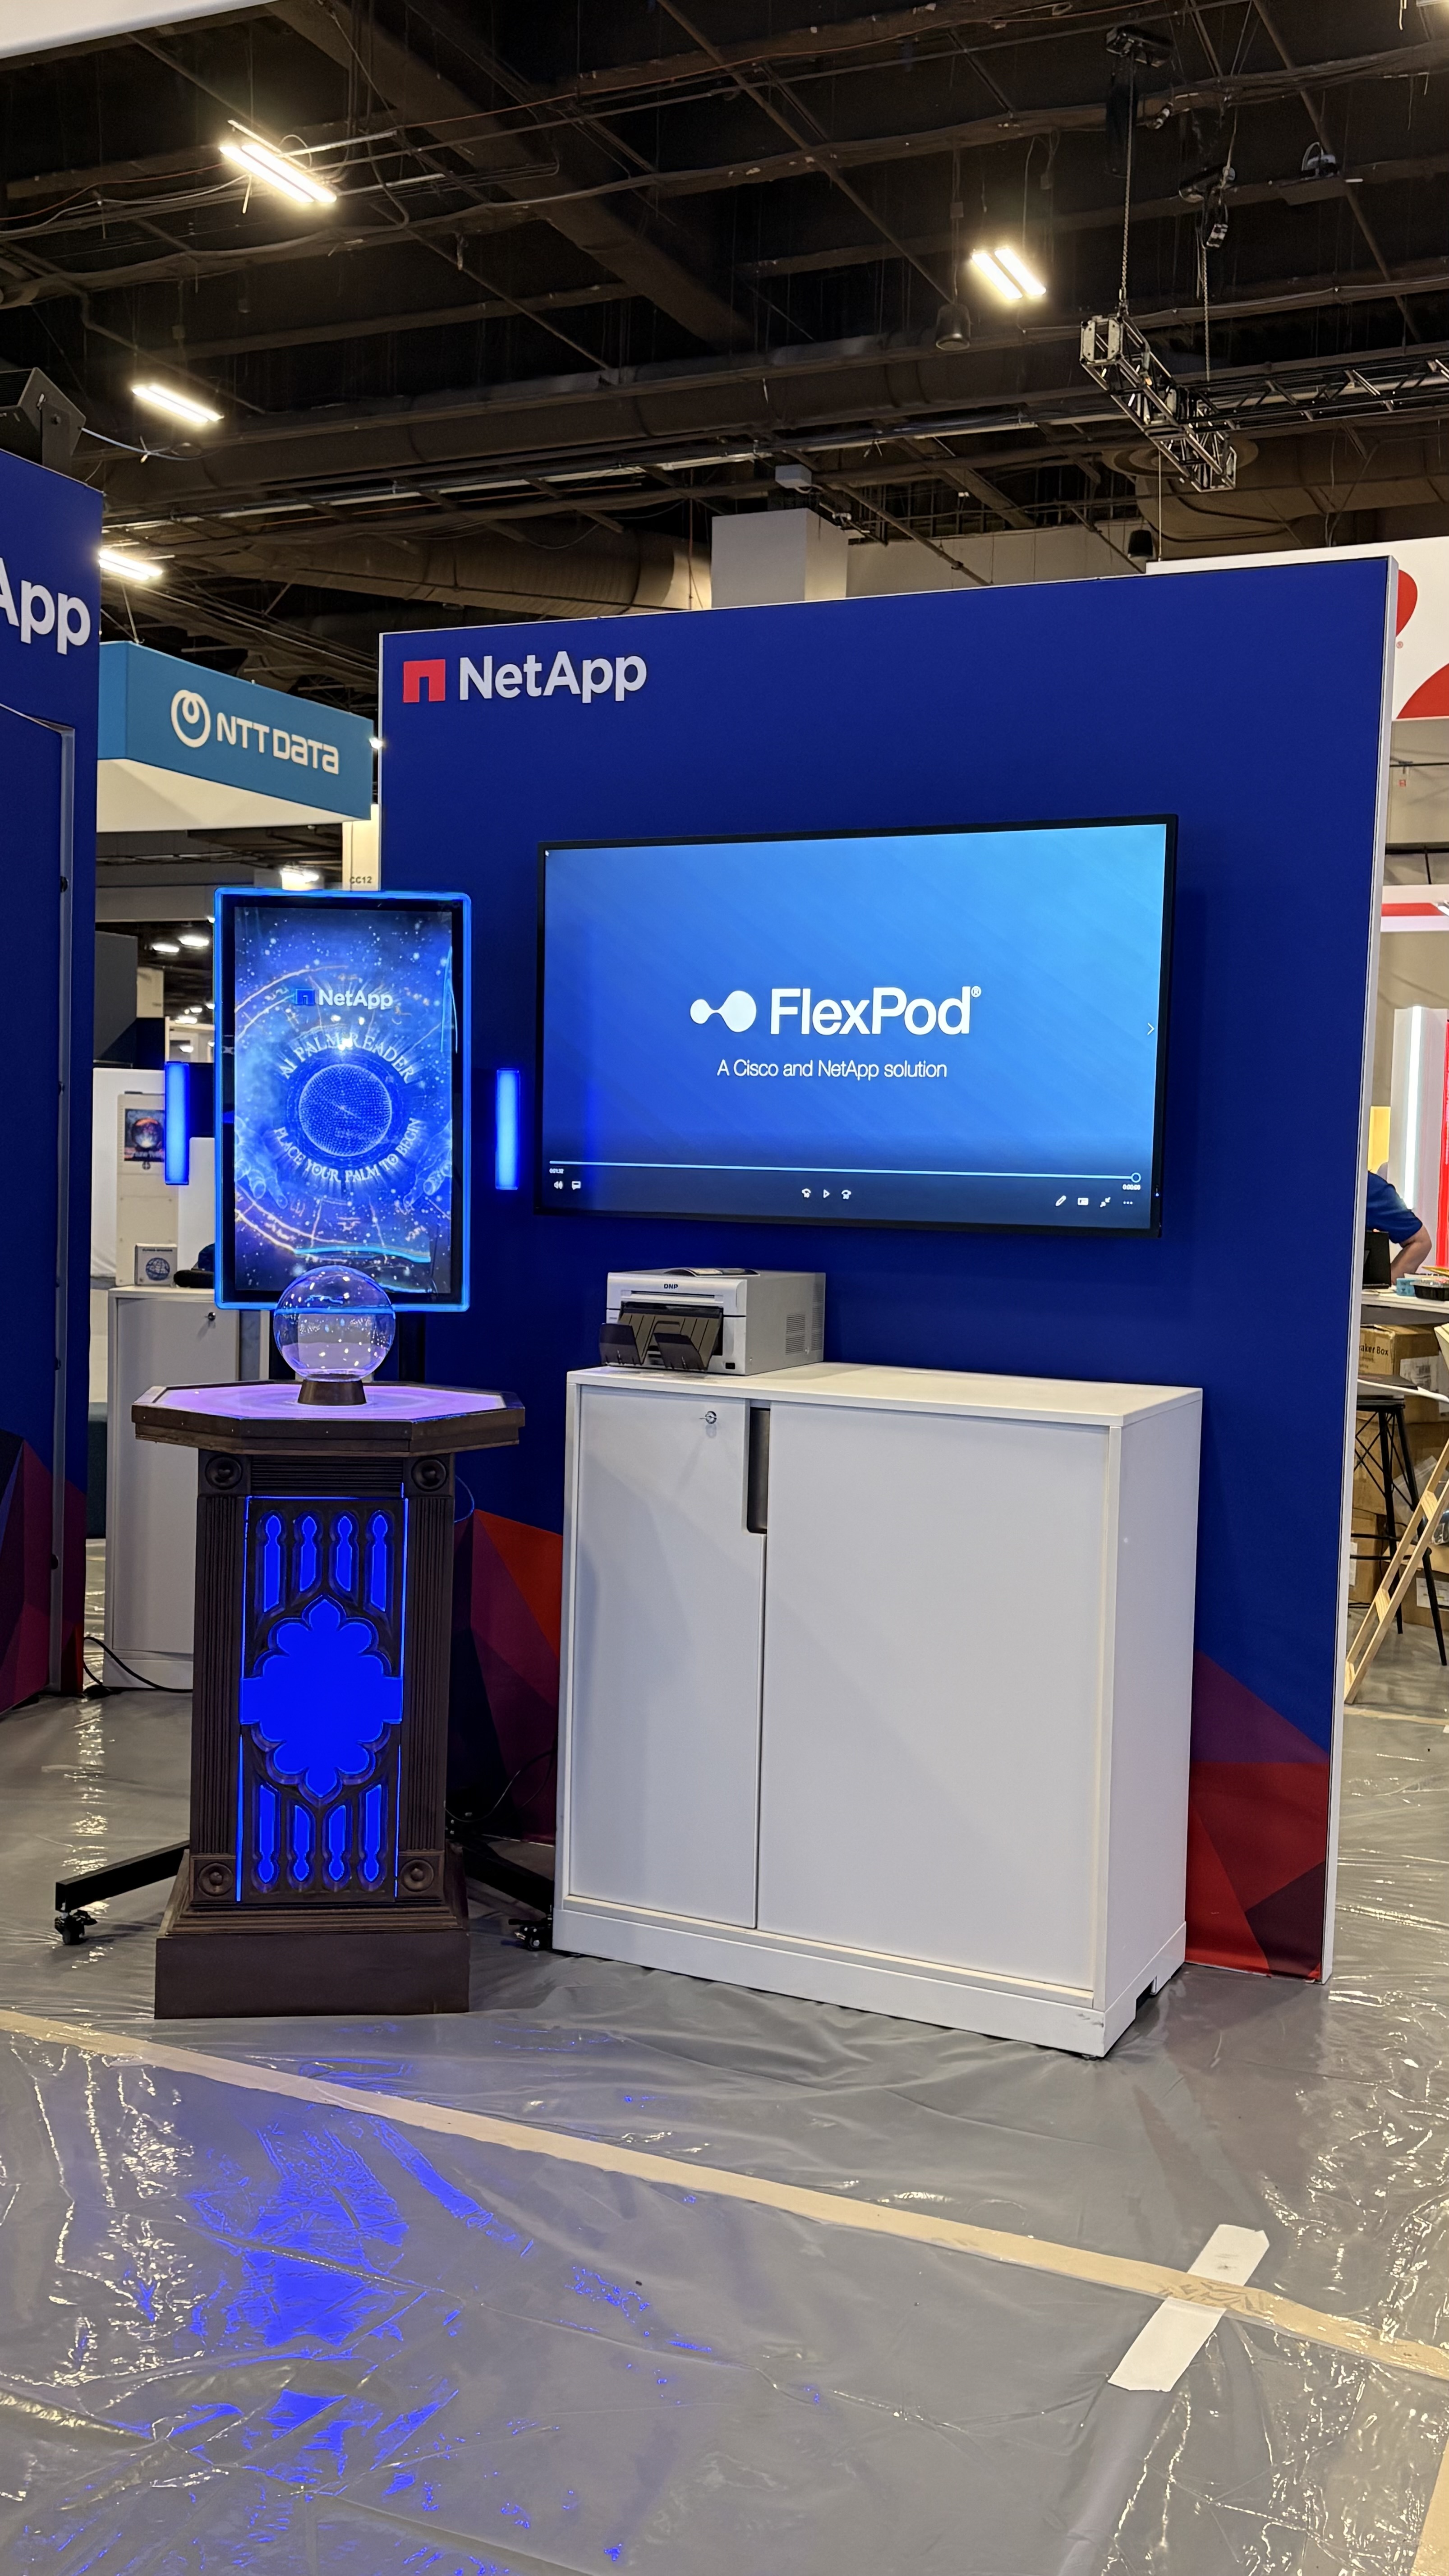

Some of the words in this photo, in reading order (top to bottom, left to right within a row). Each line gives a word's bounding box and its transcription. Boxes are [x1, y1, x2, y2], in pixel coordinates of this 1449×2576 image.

[460, 651, 647, 704] NetApp
[217, 712, 270, 753] NTT
[318, 989, 393, 1010] NetApp
[278, 1058, 298, 1079] AI
[294, 1032, 341, 1063] PALM
[349, 1032, 414, 1084] READER
[717, 1060, 730, 1076] A
[733, 1059, 779, 1076] Cisco
[783, 1060, 813, 1076] and
[818, 1060, 879, 1081] NetApp
[884, 1060, 947, 1078] solution
[274, 1127, 306, 1165] PLACE
[304, 1158, 341, 1182] YOUR
[345, 1164, 381, 1182] PALM
[378, 1153, 399, 1171] TO
[395, 1117, 422, 1156] BEGIN
[1359, 1344, 1375, 1353] aker
[1376, 1346, 1389, 1356] Box
